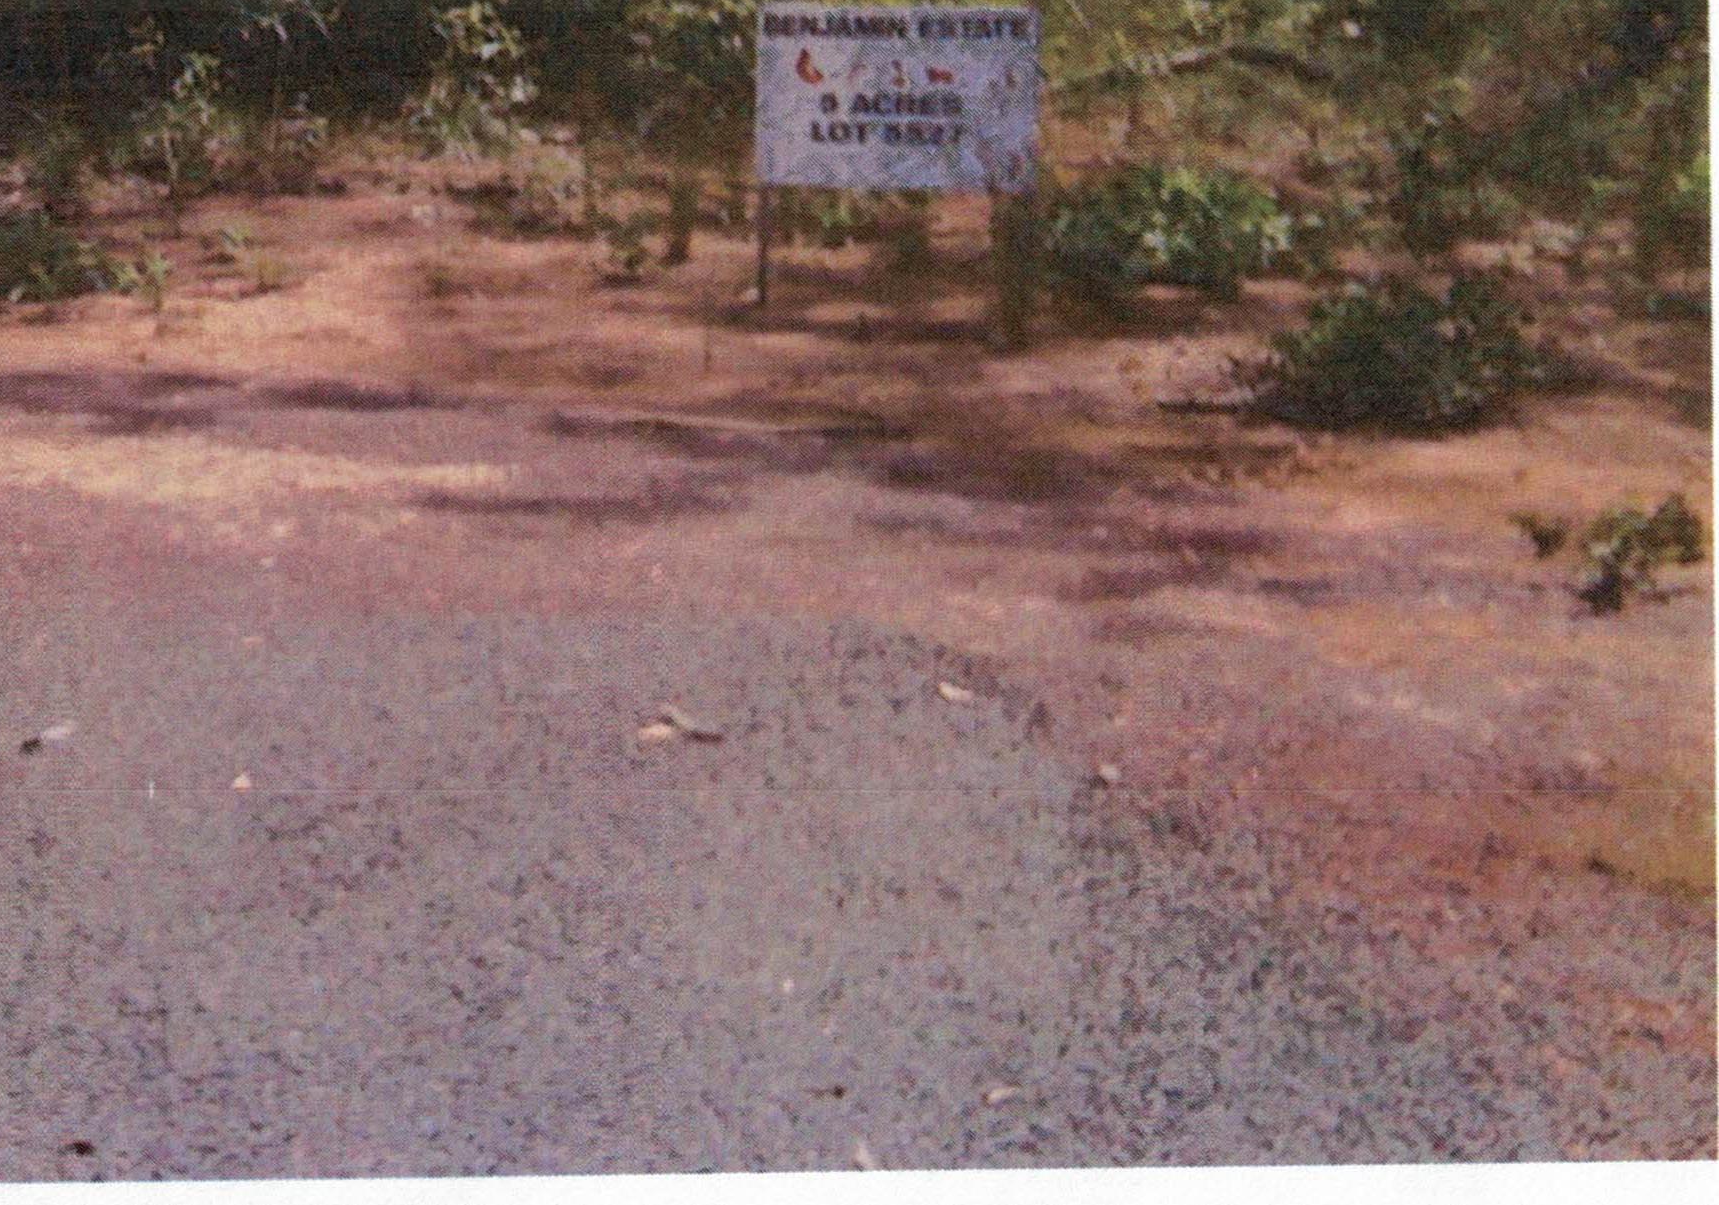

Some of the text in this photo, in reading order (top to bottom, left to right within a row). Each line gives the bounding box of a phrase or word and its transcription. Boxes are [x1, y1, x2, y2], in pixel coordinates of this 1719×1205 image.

[763, 13, 1030, 41] BENJAMIN ESTATE
[849, 91, 964, 116] ACRES
[810, 119, 874, 144] LOT
